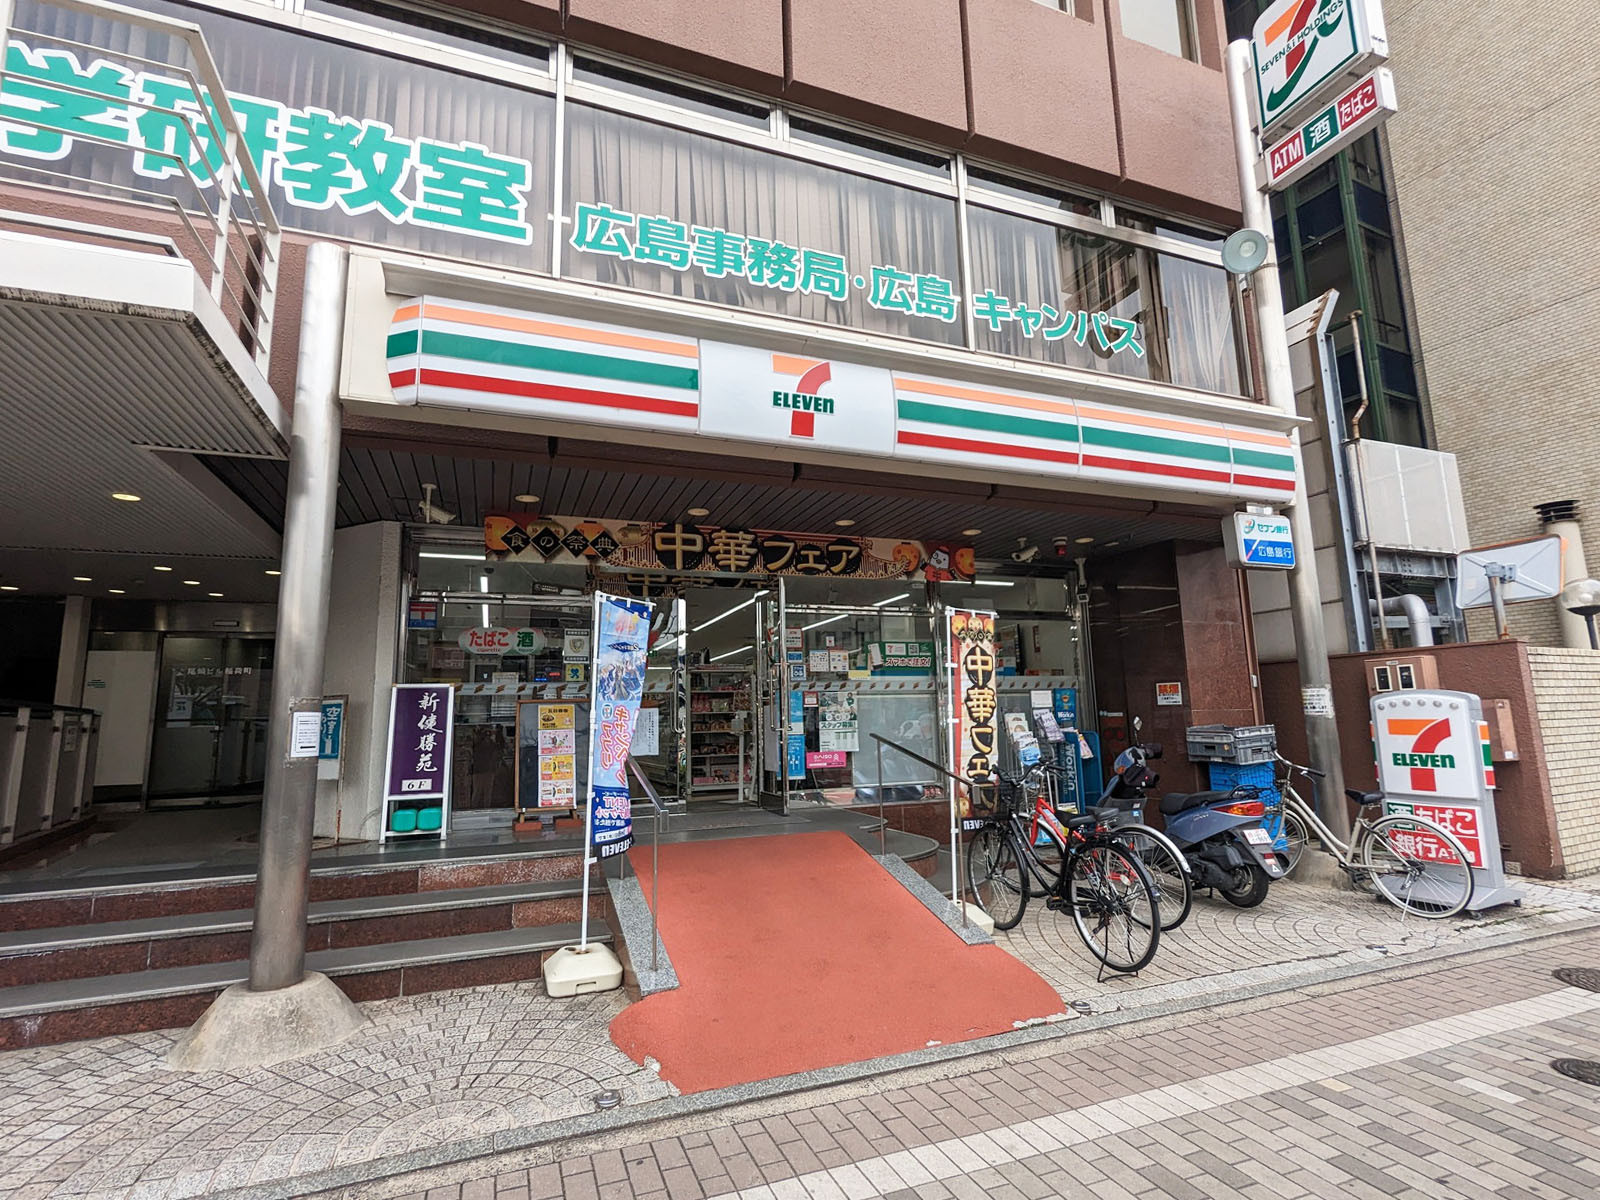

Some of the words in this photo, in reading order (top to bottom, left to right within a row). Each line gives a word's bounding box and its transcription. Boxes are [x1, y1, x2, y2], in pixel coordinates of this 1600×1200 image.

[1297, 0, 1344, 42] HOLDINGS
[0, 43, 530, 243] 学研教室
[1273, 137, 1301, 174] ATM
[1309, 114, 1331, 149] 酒
[1339, 84, 1376, 126] たばこ
[973, 289, 1146, 359] キャンパス
[506, 531, 615, 552] 食の祭典
[654, 522, 861, 574] 中華フェア
[1257, 545, 1292, 559] 広島銀行
[469, 630, 510, 647] たばこ
[516, 631, 534, 648] 酒
